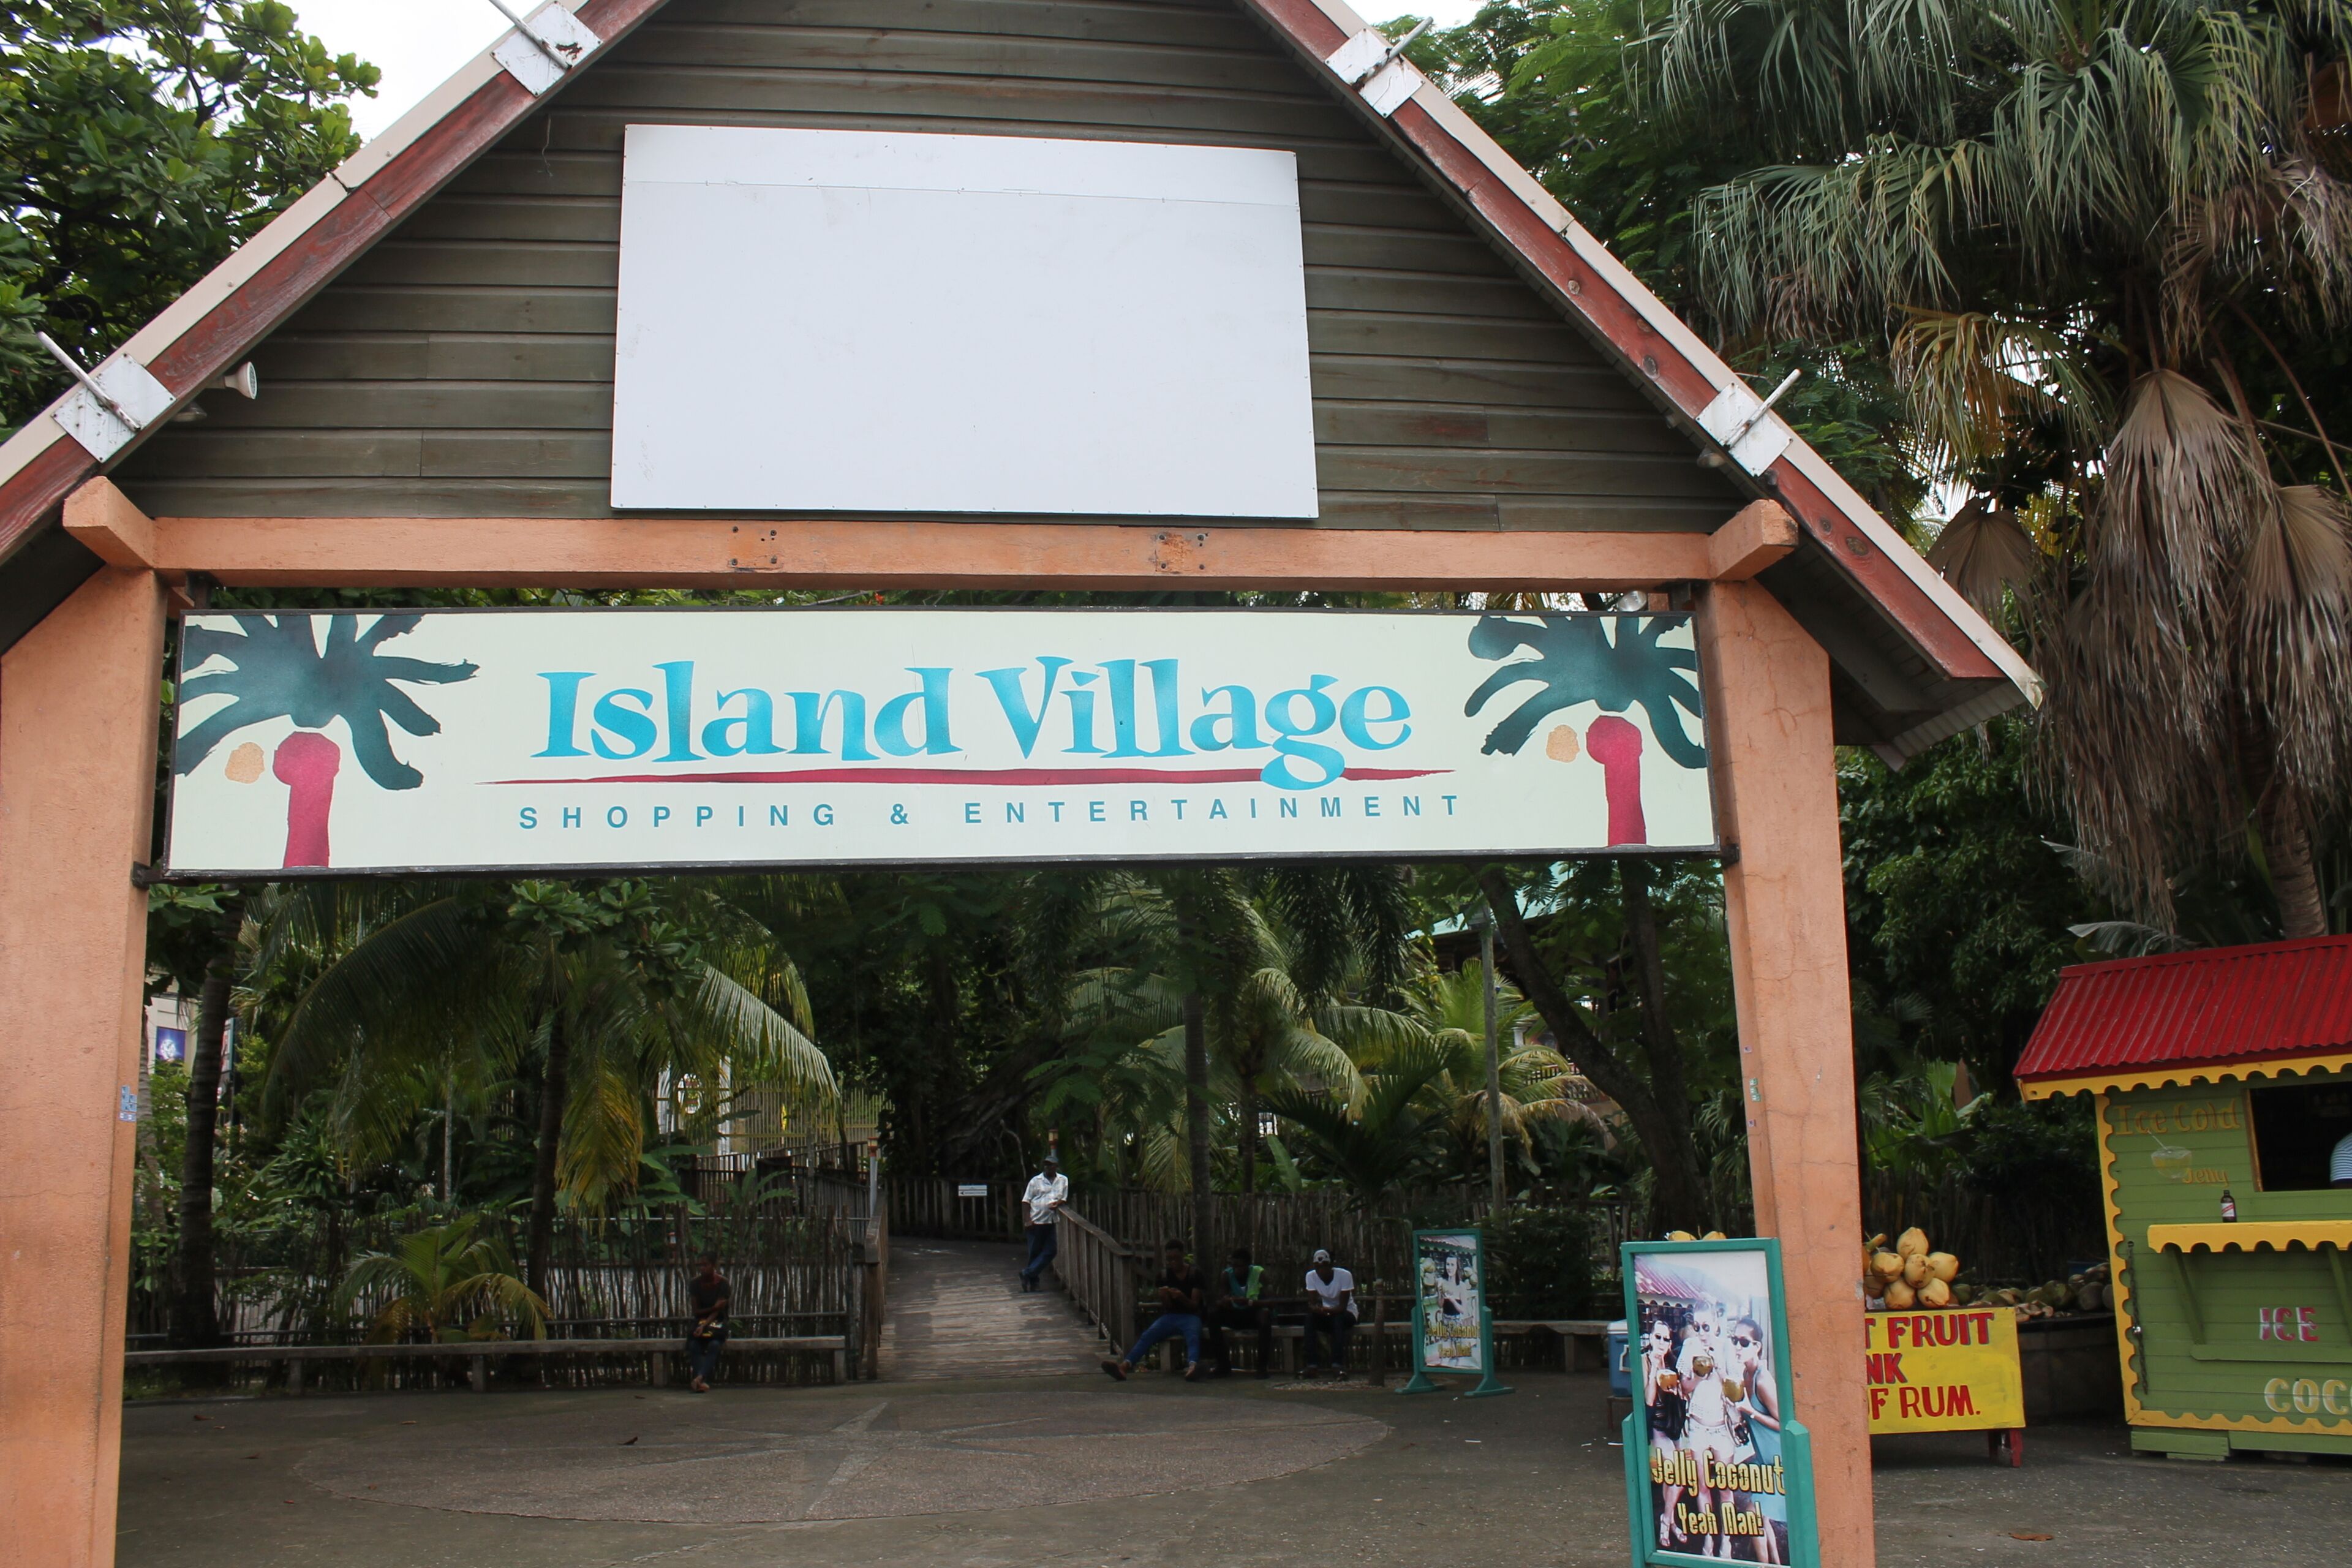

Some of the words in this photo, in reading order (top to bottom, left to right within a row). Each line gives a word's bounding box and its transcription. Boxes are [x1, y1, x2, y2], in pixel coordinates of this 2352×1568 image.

[530, 660, 964, 763] Island
[974, 655, 1412, 791] Village
[519, 804, 835, 829] SHOPPING
[890, 803, 910, 826] &
[965, 794, 1457, 824] ENTERTAINMENT
[2114, 1105, 2168, 1136] Ice
[2174, 1098, 2241, 1132] Cold
[2182, 1167, 2229, 1188] Jelly
[1887, 1312, 1995, 1349] FRUIT
[2260, 1306, 2320, 1341] ICE
[1868, 1388, 1889, 1420] F
[1899, 1385, 1981, 1418] RUM.
[2264, 1378, 2352, 1415] COC
[1651, 1447, 1699, 1497] Jelly
[1702, 1449, 1785, 1495] Coconut
[1676, 1502, 1718, 1535] Yeah
[1721, 1501, 1765, 1536] Man!
